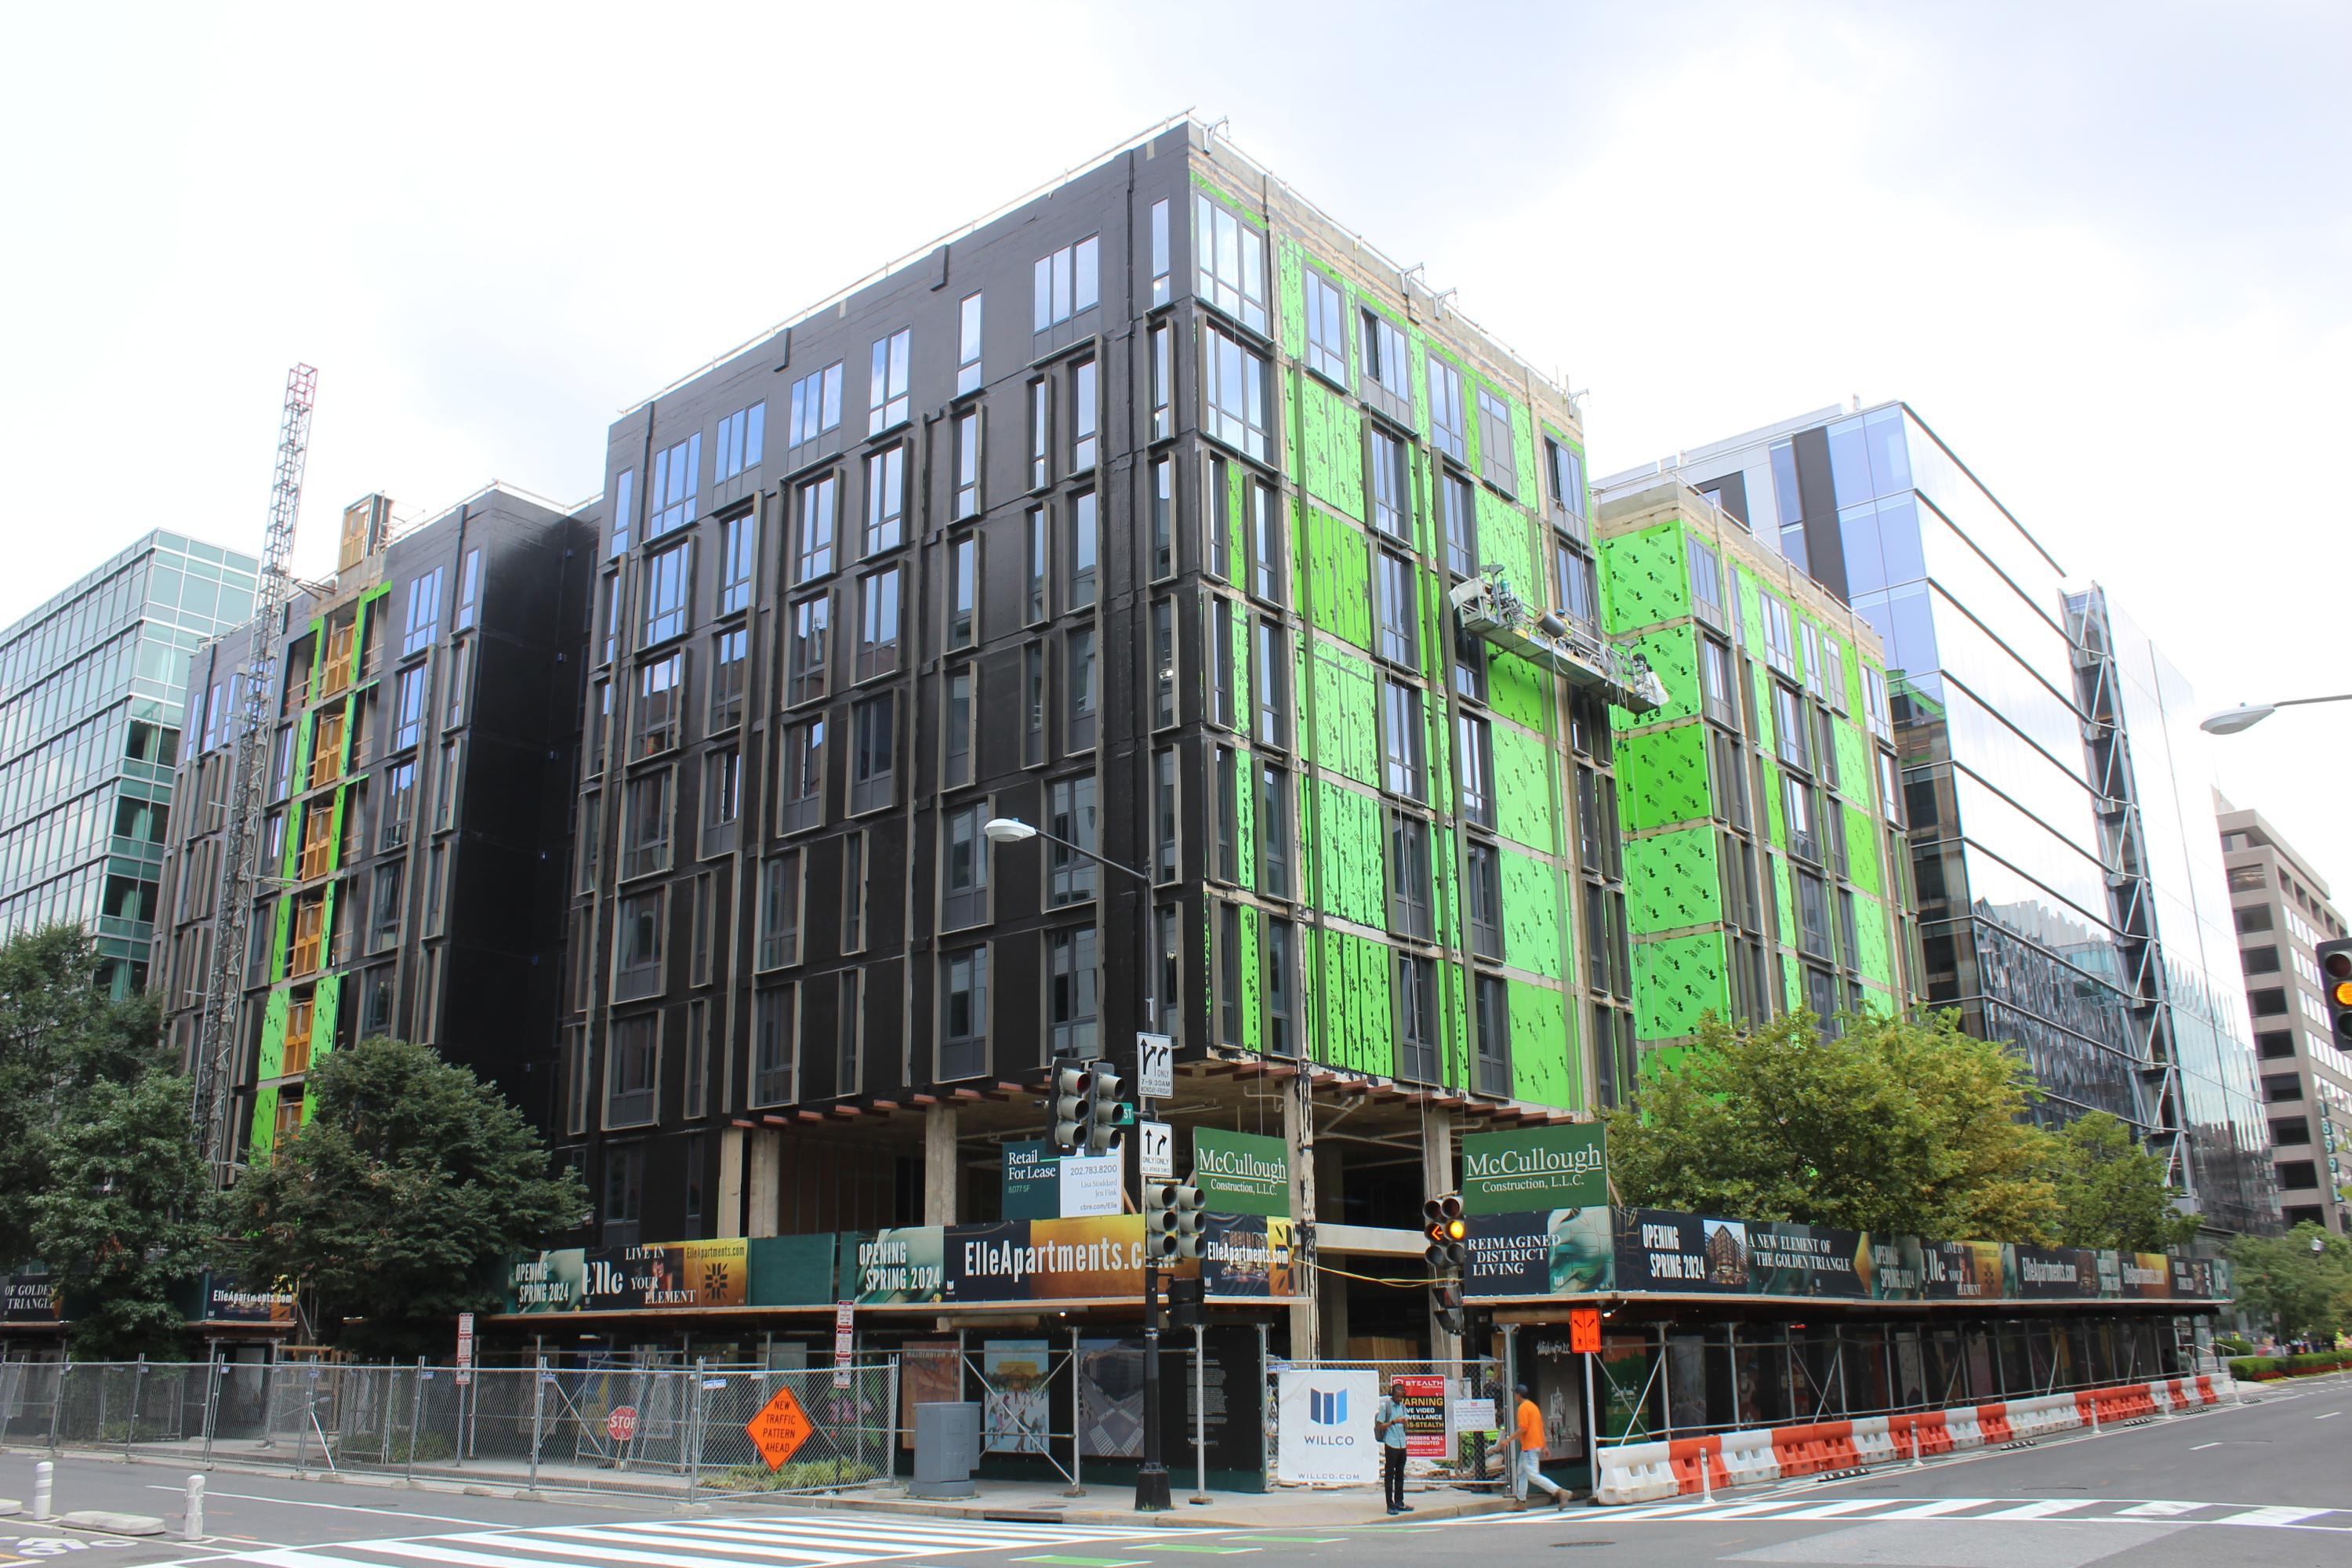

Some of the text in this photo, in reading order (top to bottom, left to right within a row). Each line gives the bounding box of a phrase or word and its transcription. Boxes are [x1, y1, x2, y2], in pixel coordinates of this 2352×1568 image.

[1157, 1069, 1170, 1078] ONLY
[1141, 1078, 1171, 1087] 7-9:30AM
[1140, 1086, 1170, 1094] MONDAY-FRIDAY
[1123, 1109, 1132, 1120] ST
[1008, 1149, 1038, 1165] Retail
[1156, 1157, 1169, 1166] ONLY
[1466, 1142, 1602, 1177] McCullough
[1008, 1165, 1056, 1181] For Lease
[1070, 1164, 1117, 1176] 202.783.8200
[1198, 1148, 1287, 1185] McCullough
[1023, 1184, 1031, 1193] SF
[1080, 1178, 1117, 1189] Lisa Stoddard
[1210, 1178, 1277, 1196] Construction, L.L.C.
[1482, 1174, 1584, 1193] Construction, L.L.C.
[1080, 1203, 1117, 1211] cbre.com/Elle
[1468, 1234, 1561, 1251] REIMAGINED
[1642, 1223, 1679, 1250] OPENING
[1748, 1233, 1831, 1254] A NEW ELEMENT OF
[626, 1245, 665, 1261] LIVE IN
[687, 1246, 745, 1261] ElleApartments.com
[858, 1241, 906, 1265] OPENING
[1207, 1241, 1289, 1266] ElleApartments.com
[1875, 1244, 1899, 1265] OPENING
[1944, 1242, 1964, 1254] LIVE IN
[1476, 1247, 1548, 1264] DISTRICT
[1755, 1251, 1851, 1272] THE GOLDEN TRIANGLE
[516, 1261, 548, 1282] OPENING
[1472, 1262, 1525, 1276] LIVING
[1650, 1253, 1705, 1279] SPRING 2024
[582, 1261, 623, 1295] Elle
[631, 1276, 659, 1290] YOUR
[866, 1266, 941, 1291] SPRING 2024
[1880, 1267, 1900, 1288] SPRING
[1948, 1270, 1964, 1282] YOUR
[5, 1285, 16, 1296] OF
[519, 1283, 569, 1303] SPRING 2024
[1958, 1283, 1981, 1296] ELEMENT
[8, 1298, 55, 1309] TRIANGLE
[213, 1290, 292, 1304] ElleApartments.com
[645, 1290, 696, 1305] ELEMENT
[775, 1401, 790, 1410] NEW
[609, 1417, 636, 1428] STOP
[766, 1414, 796, 1425] TRAFFIC
[763, 1428, 795, 1439] PATTERN
[1305, 1436, 1354, 1446] WILLCO
[765, 1443, 789, 1454] AHEAD
